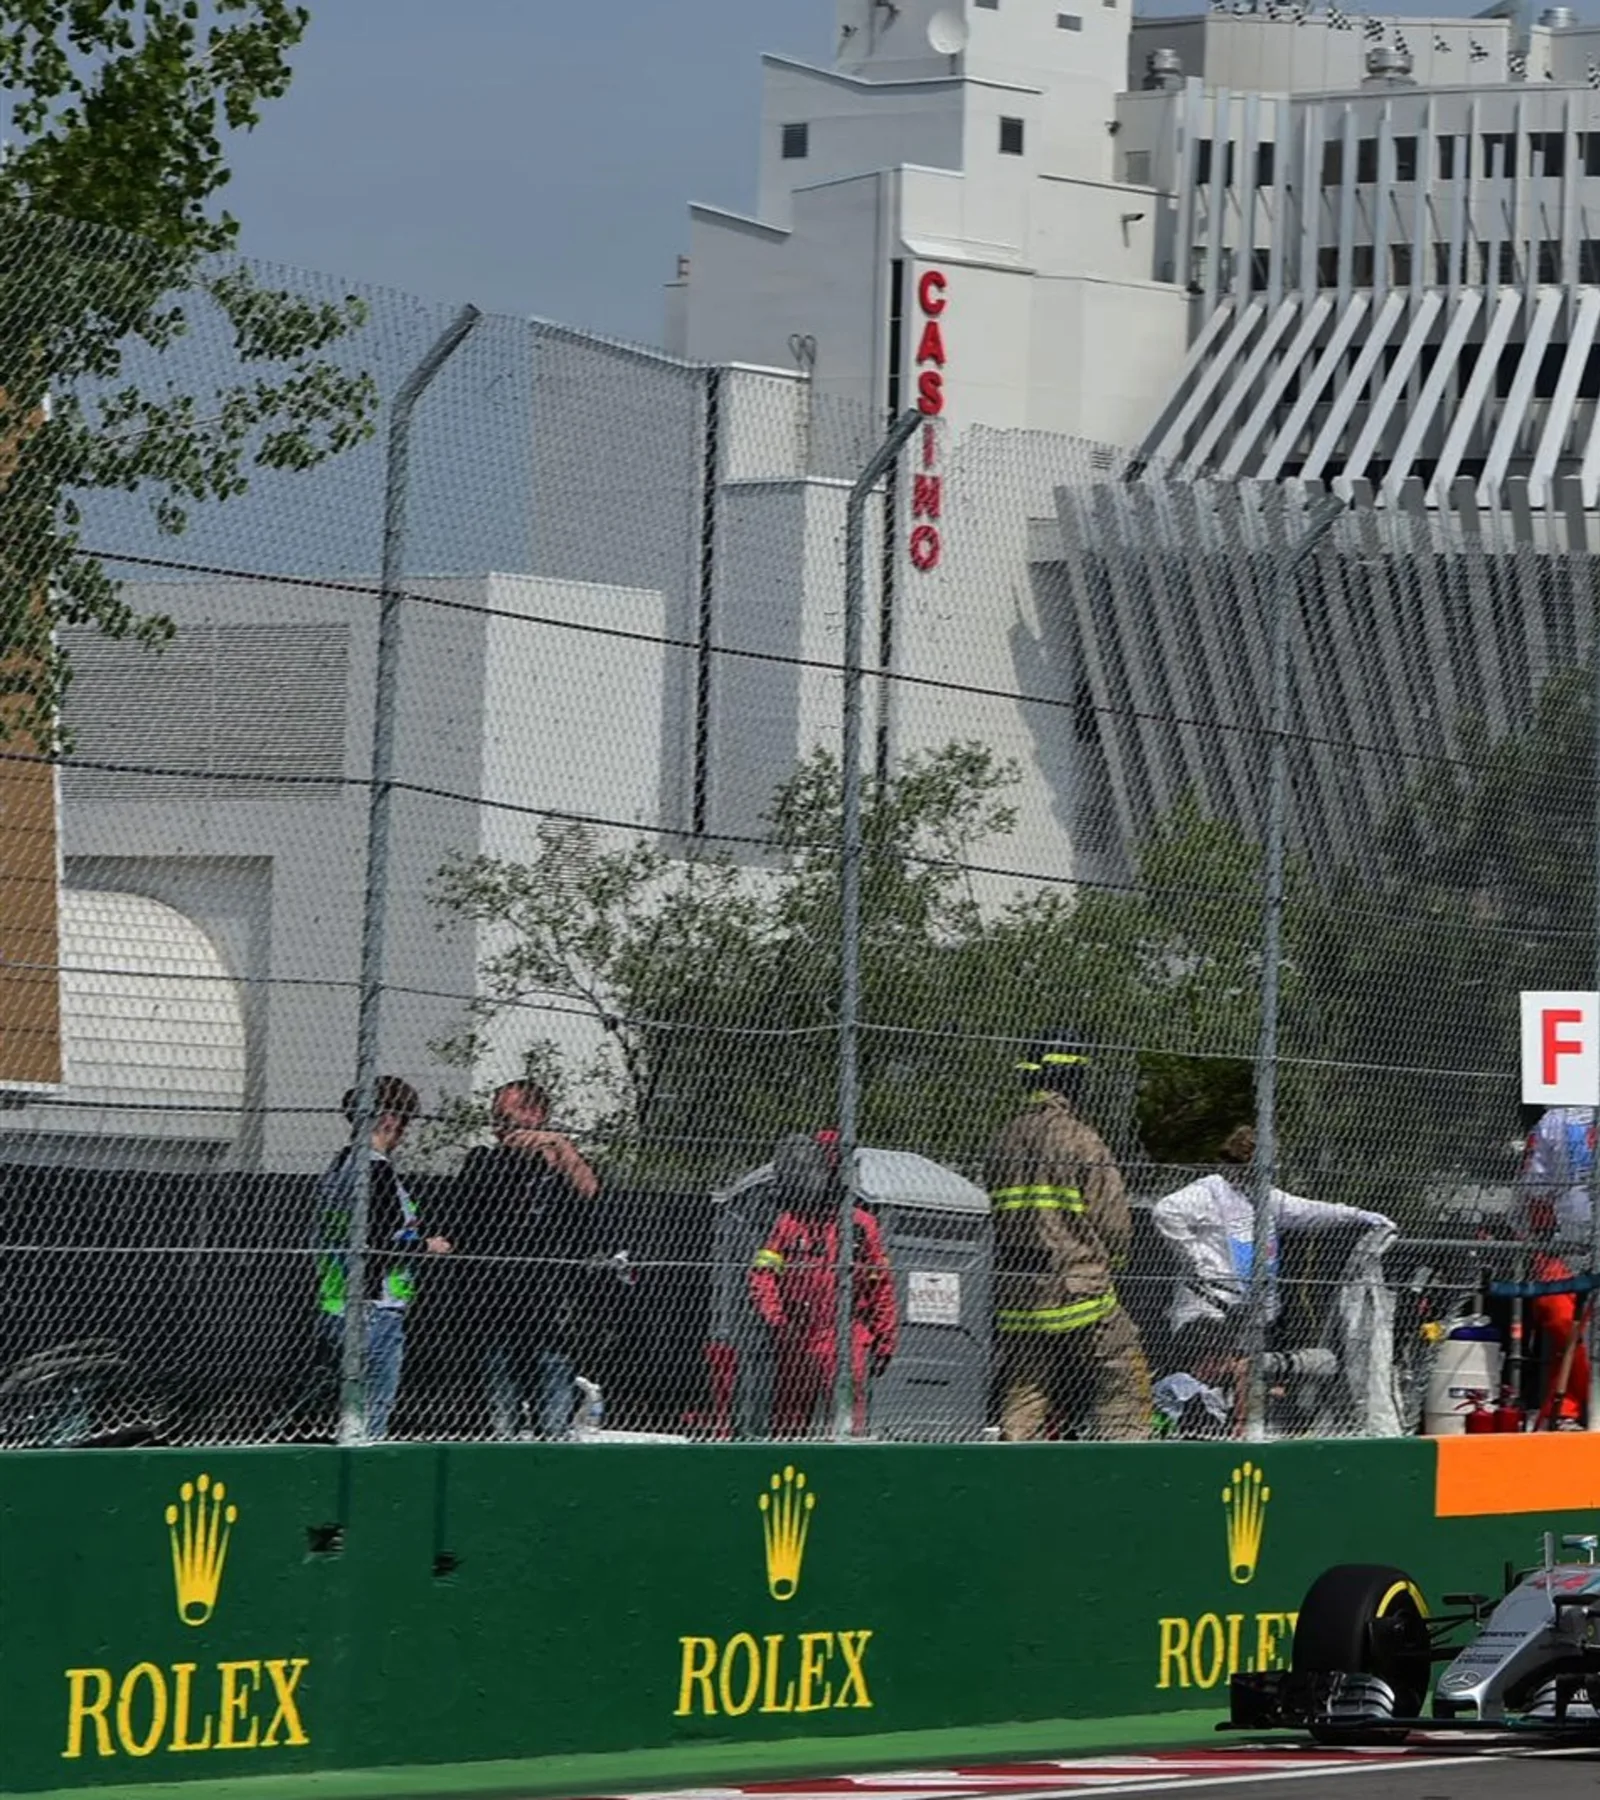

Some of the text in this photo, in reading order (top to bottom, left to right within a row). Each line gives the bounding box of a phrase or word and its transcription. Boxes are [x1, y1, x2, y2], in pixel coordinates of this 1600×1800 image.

[909, 270, 947, 570] CASINO
[1542, 1009, 1583, 1085] F
[62, 1658, 310, 1759] ROLEX
[677, 1629, 874, 1717] ROLEX
